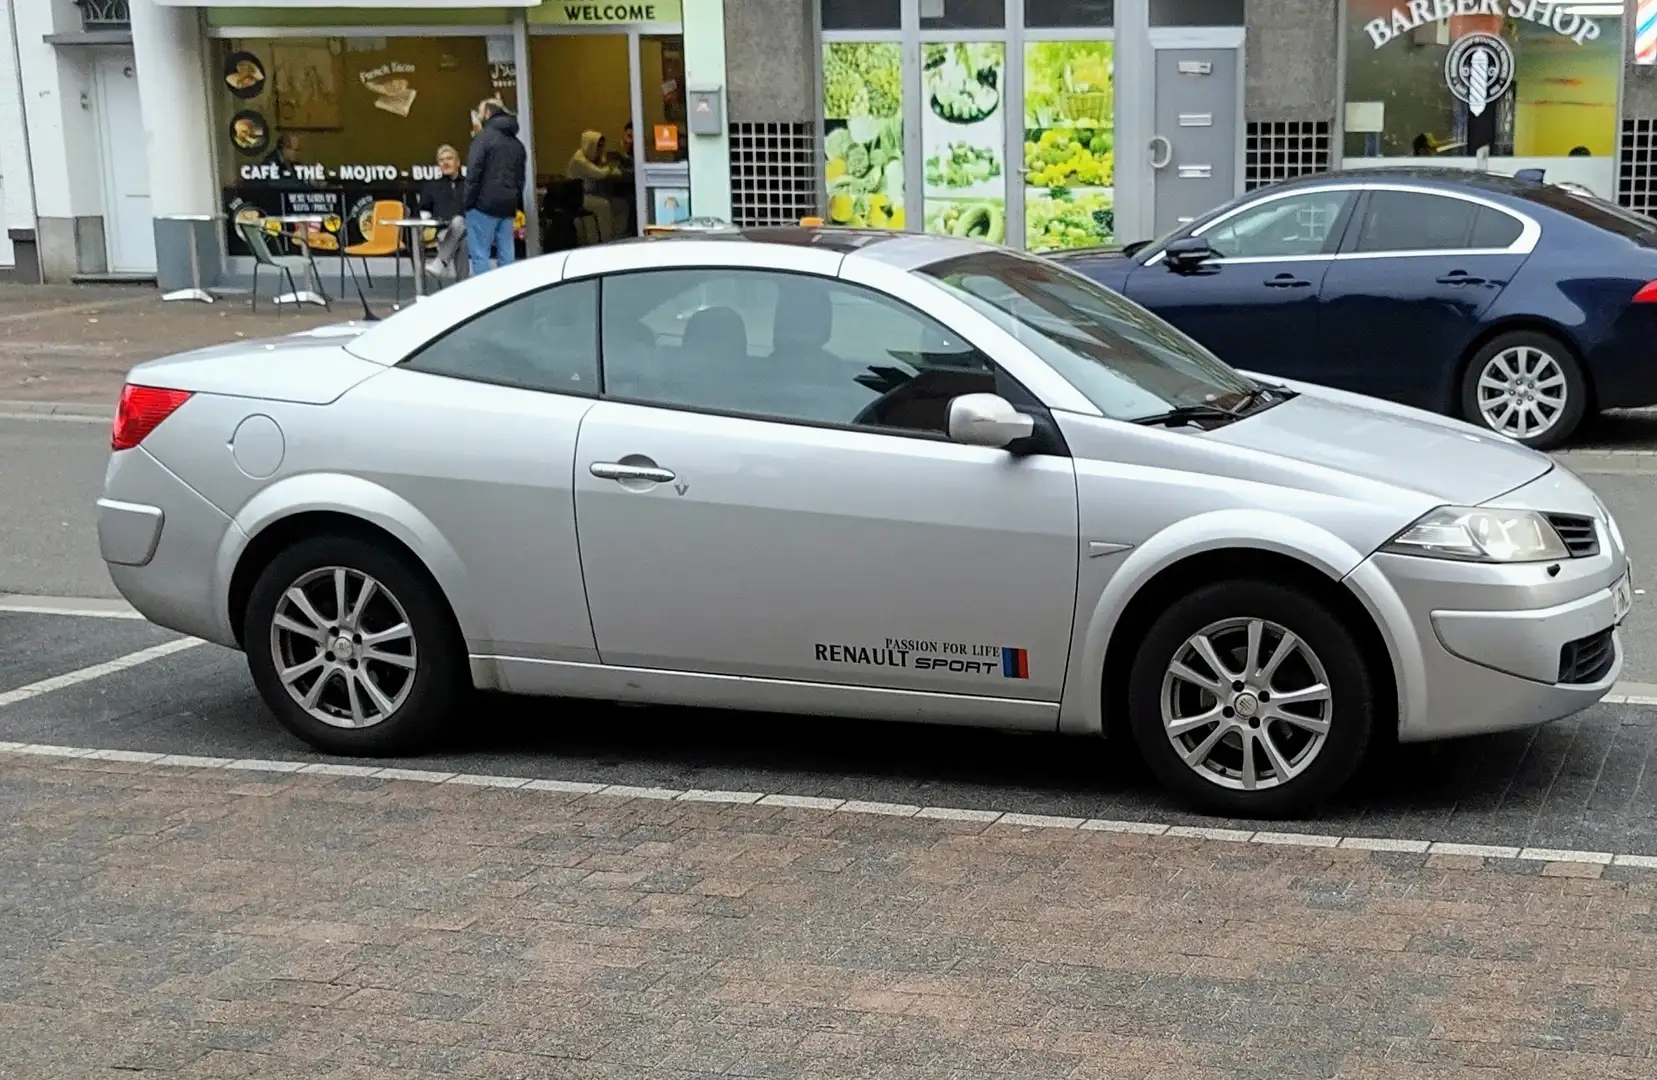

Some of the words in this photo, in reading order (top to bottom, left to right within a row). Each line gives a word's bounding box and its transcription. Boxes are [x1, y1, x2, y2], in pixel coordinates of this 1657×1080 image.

[563, 5, 656, 20] WELCOME
[1363, 0, 1503, 49] BARBER
[1508, 0, 1600, 45] SHOP
[340, 165, 398, 183] MOJITO
[885, 637, 938, 653] PASSION
[943, 641, 968, 656] FOR
[972, 644, 1000, 658] LIFE
[814, 643, 909, 667] RENAULT
[914, 657, 998, 674] SPORT
